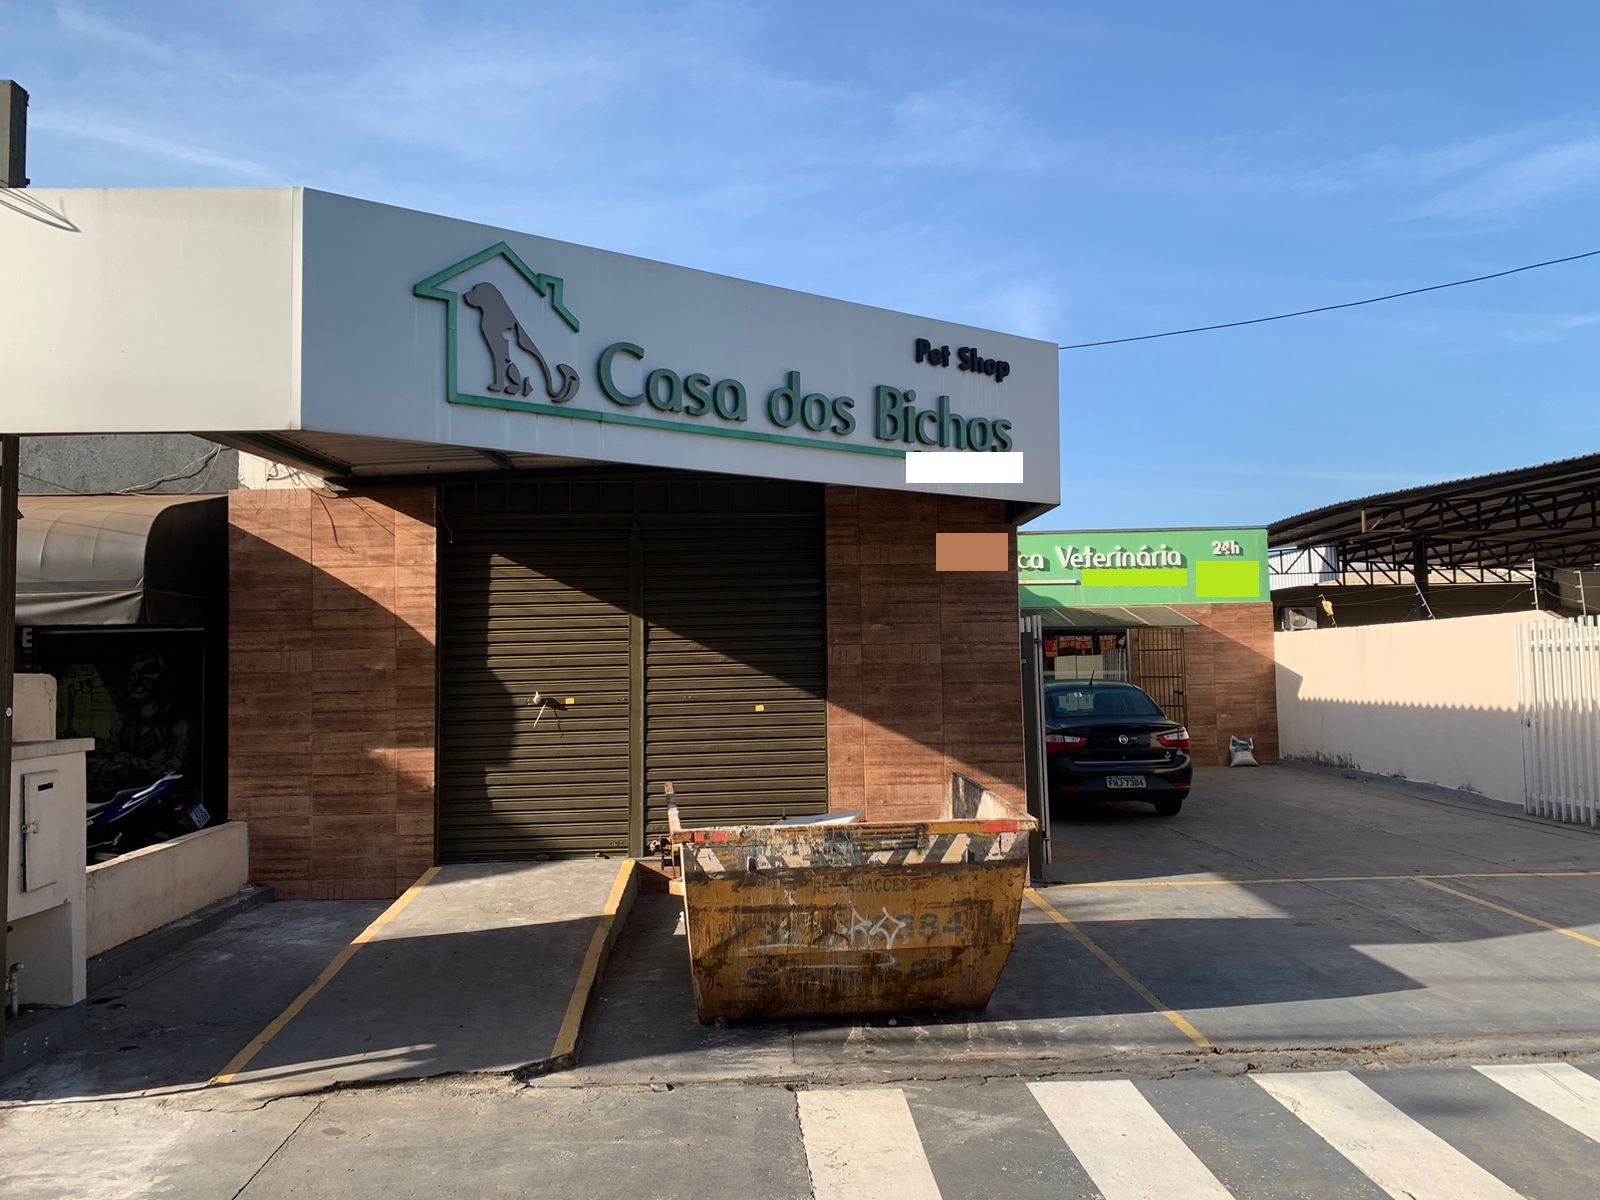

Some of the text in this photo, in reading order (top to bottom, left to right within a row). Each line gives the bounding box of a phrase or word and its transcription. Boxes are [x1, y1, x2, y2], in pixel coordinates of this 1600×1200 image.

[915, 338, 1010, 382] Pet Shop
[598, 341, 1013, 452] Casa dos Bichos
[1055, 544, 1182, 569] Veterinária
[1211, 539, 1240, 555] 24h
